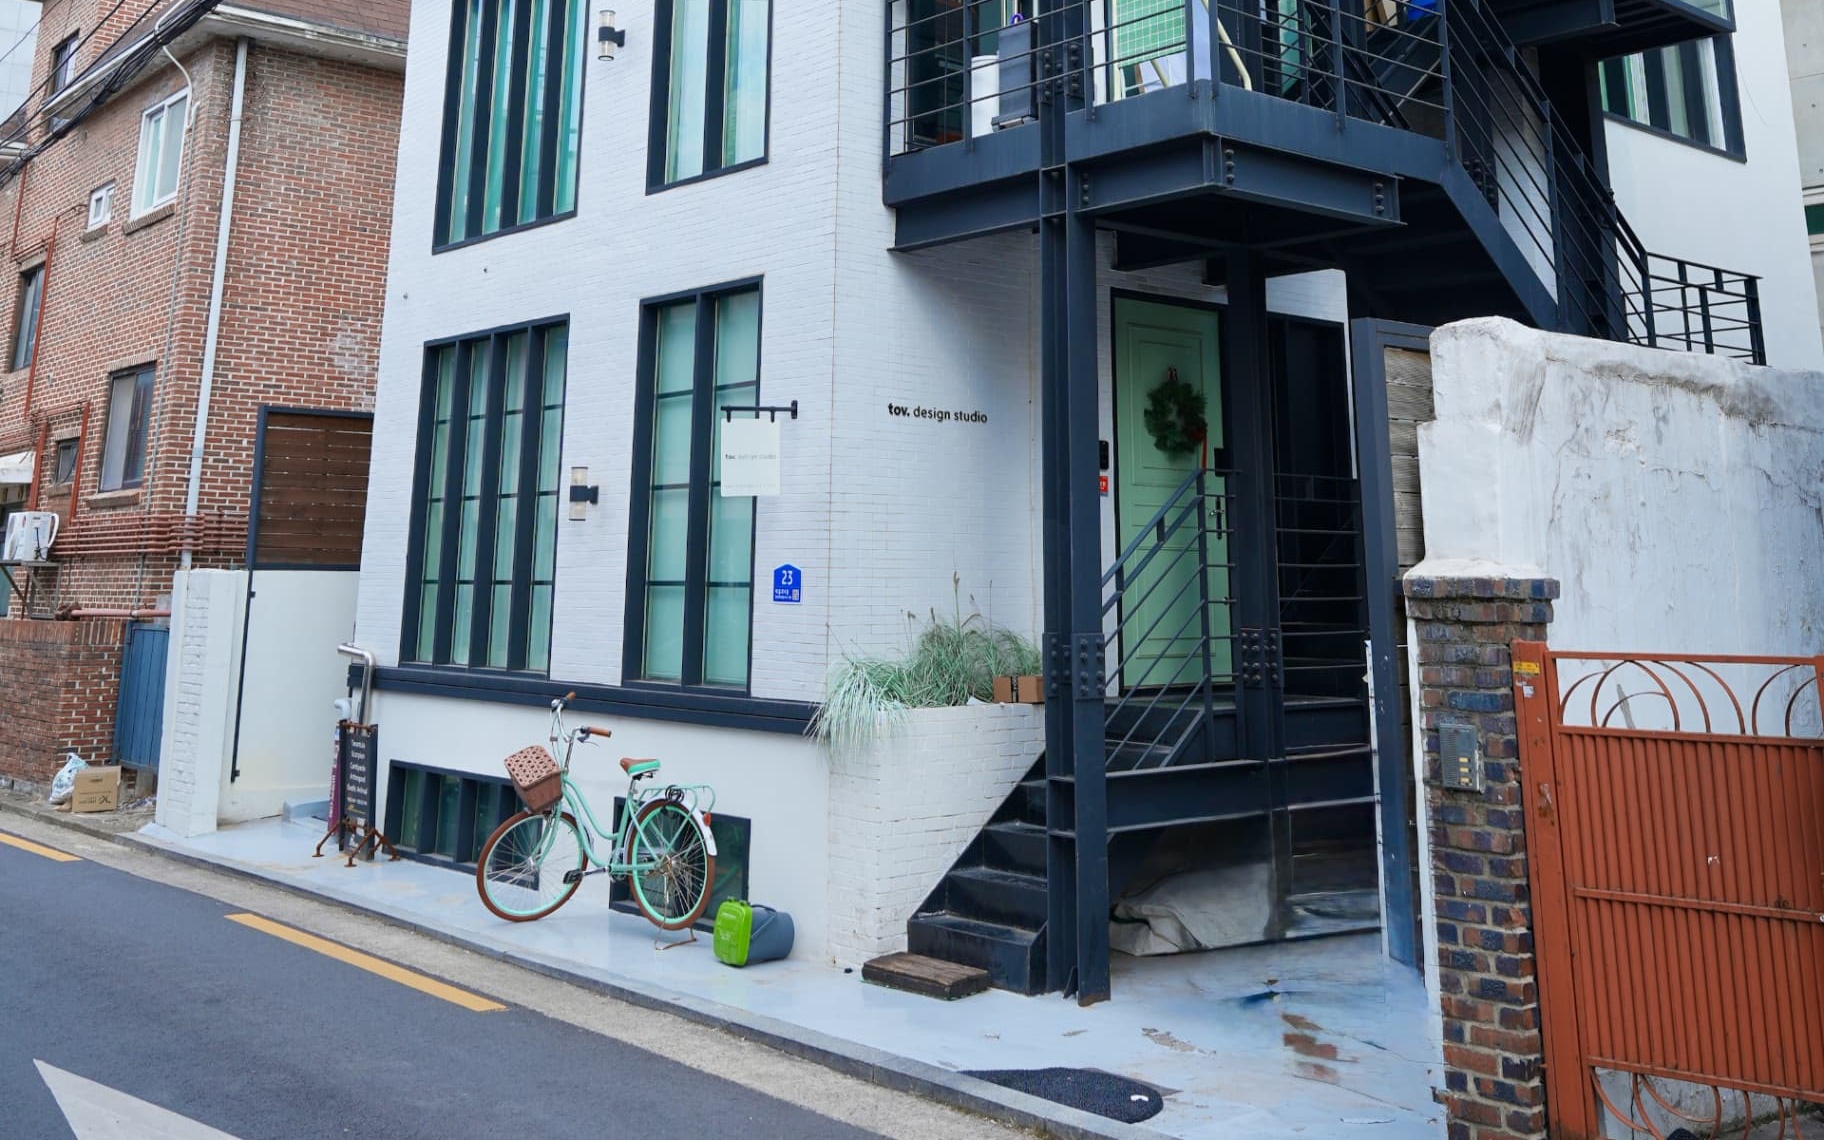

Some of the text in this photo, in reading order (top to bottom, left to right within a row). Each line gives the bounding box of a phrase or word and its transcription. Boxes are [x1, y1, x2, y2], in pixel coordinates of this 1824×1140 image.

[888, 403, 988, 423] tov. design studio
[781, 570, 793, 585] 23
